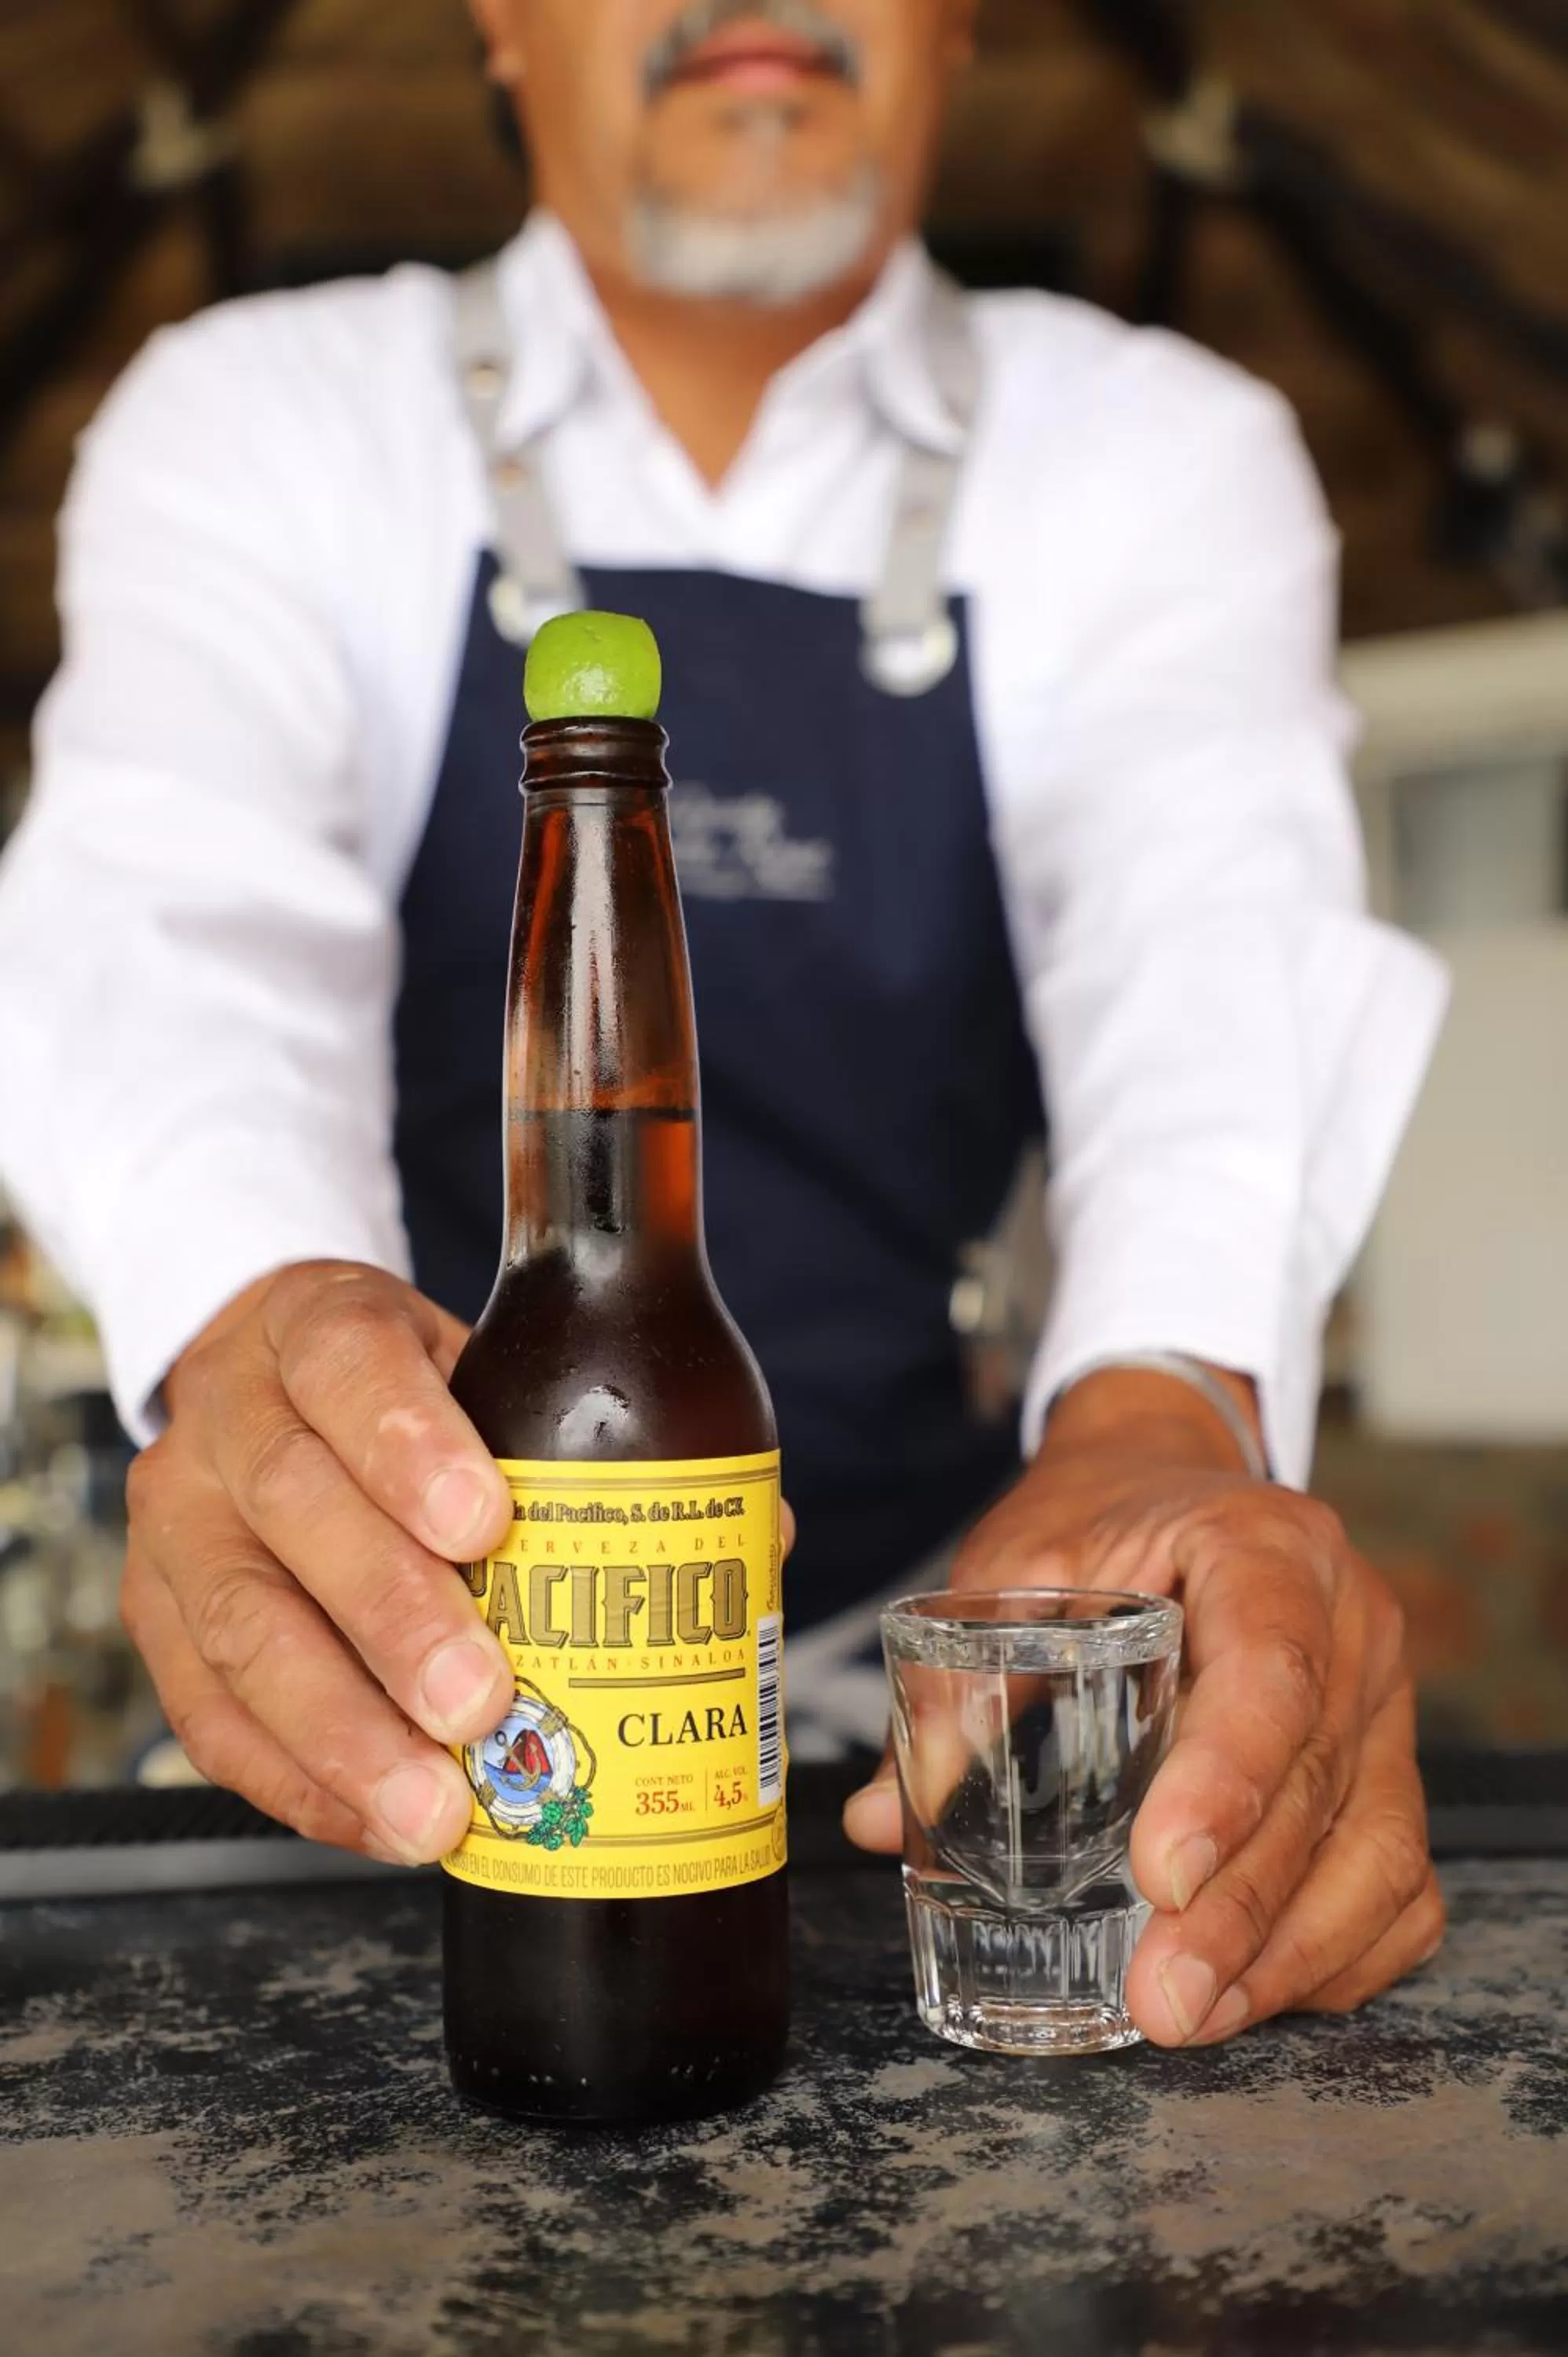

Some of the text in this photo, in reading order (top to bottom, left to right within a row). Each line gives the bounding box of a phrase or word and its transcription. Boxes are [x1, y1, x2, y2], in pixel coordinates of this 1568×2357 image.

[528, 1501, 553, 1521] del
[647, 1501, 669, 1522] de
[705, 1497, 723, 1518] de
[498, 1533, 745, 1554] ERVEZA DEL
[515, 1648, 745, 1670] ZATLÁN SINALOA
[617, 1703, 748, 1747] CLARA
[667, 1773, 694, 1786] NETO
[635, 1789, 680, 1816] 355
[493, 1858, 540, 1886] CONSUMO
[545, 1864, 559, 1886] DE
[561, 1865, 588, 1888] ESTE
[592, 1864, 654, 1889] PRODUCTO
[657, 1863, 670, 1886] ES
[673, 1860, 711, 1884] NOCIVO
[714, 1854, 738, 1880] PARA
[740, 1851, 749, 1874] LA
